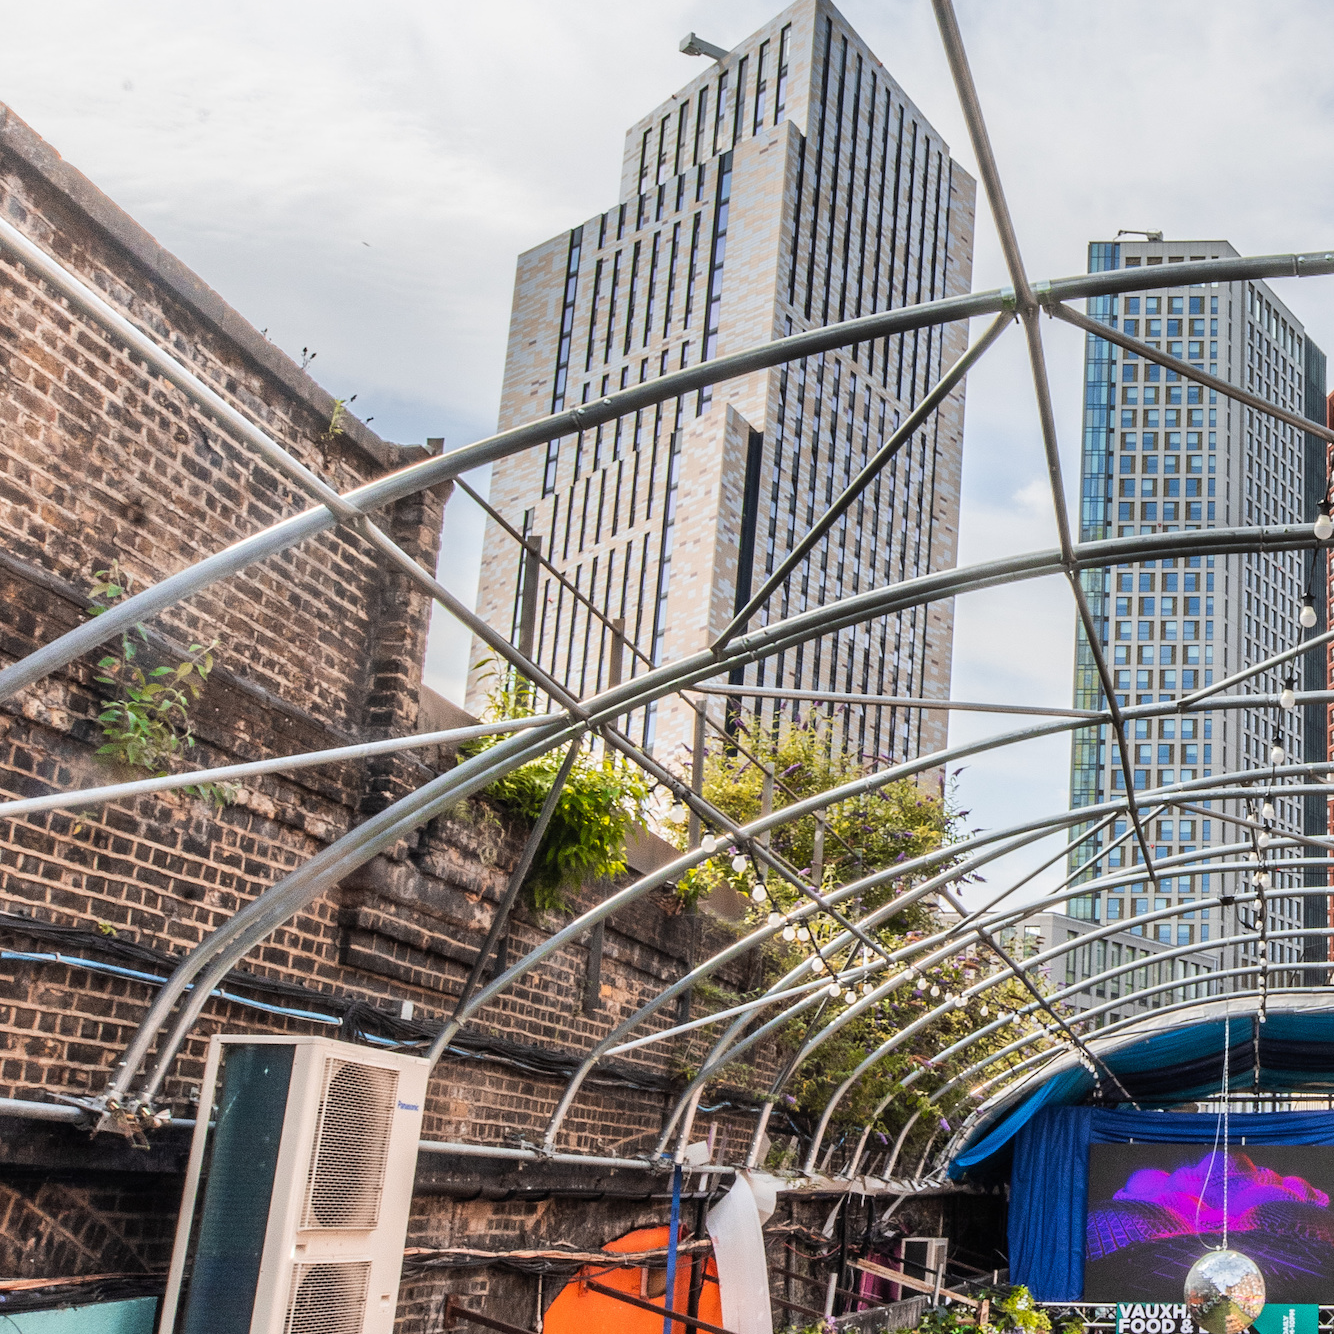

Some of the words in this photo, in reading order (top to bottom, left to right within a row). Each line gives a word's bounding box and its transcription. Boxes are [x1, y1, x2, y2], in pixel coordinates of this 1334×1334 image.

[1118, 1304, 1191, 1319] VAUXH
[1118, 1319, 1176, 1334] FOOD
[1180, 1319, 1194, 1334] &
